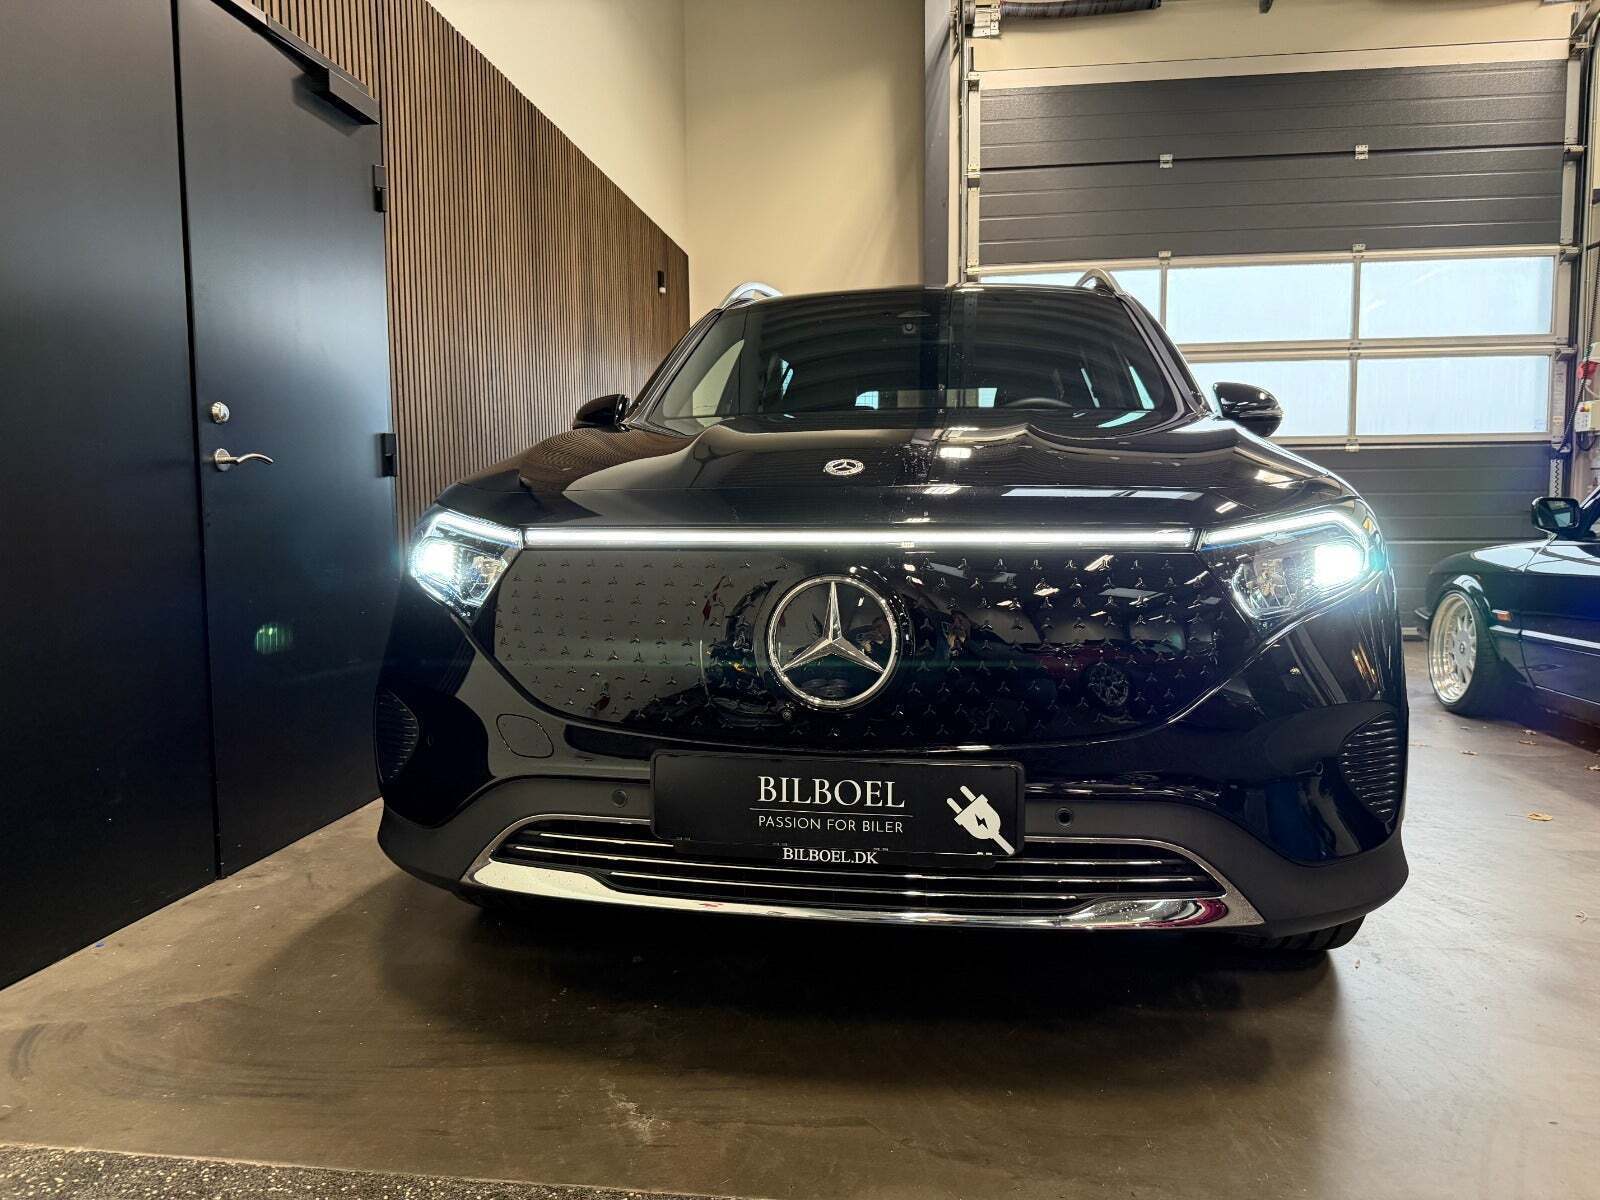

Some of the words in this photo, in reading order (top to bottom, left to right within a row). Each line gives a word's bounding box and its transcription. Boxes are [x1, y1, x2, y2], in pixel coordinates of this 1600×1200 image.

[757, 775, 905, 808] BILBOEL
[758, 815, 822, 830] PASSION
[827, 818, 857, 831] FOR
[862, 819, 904, 833] BILER
[782, 847, 879, 865] BILBOEL.DK
